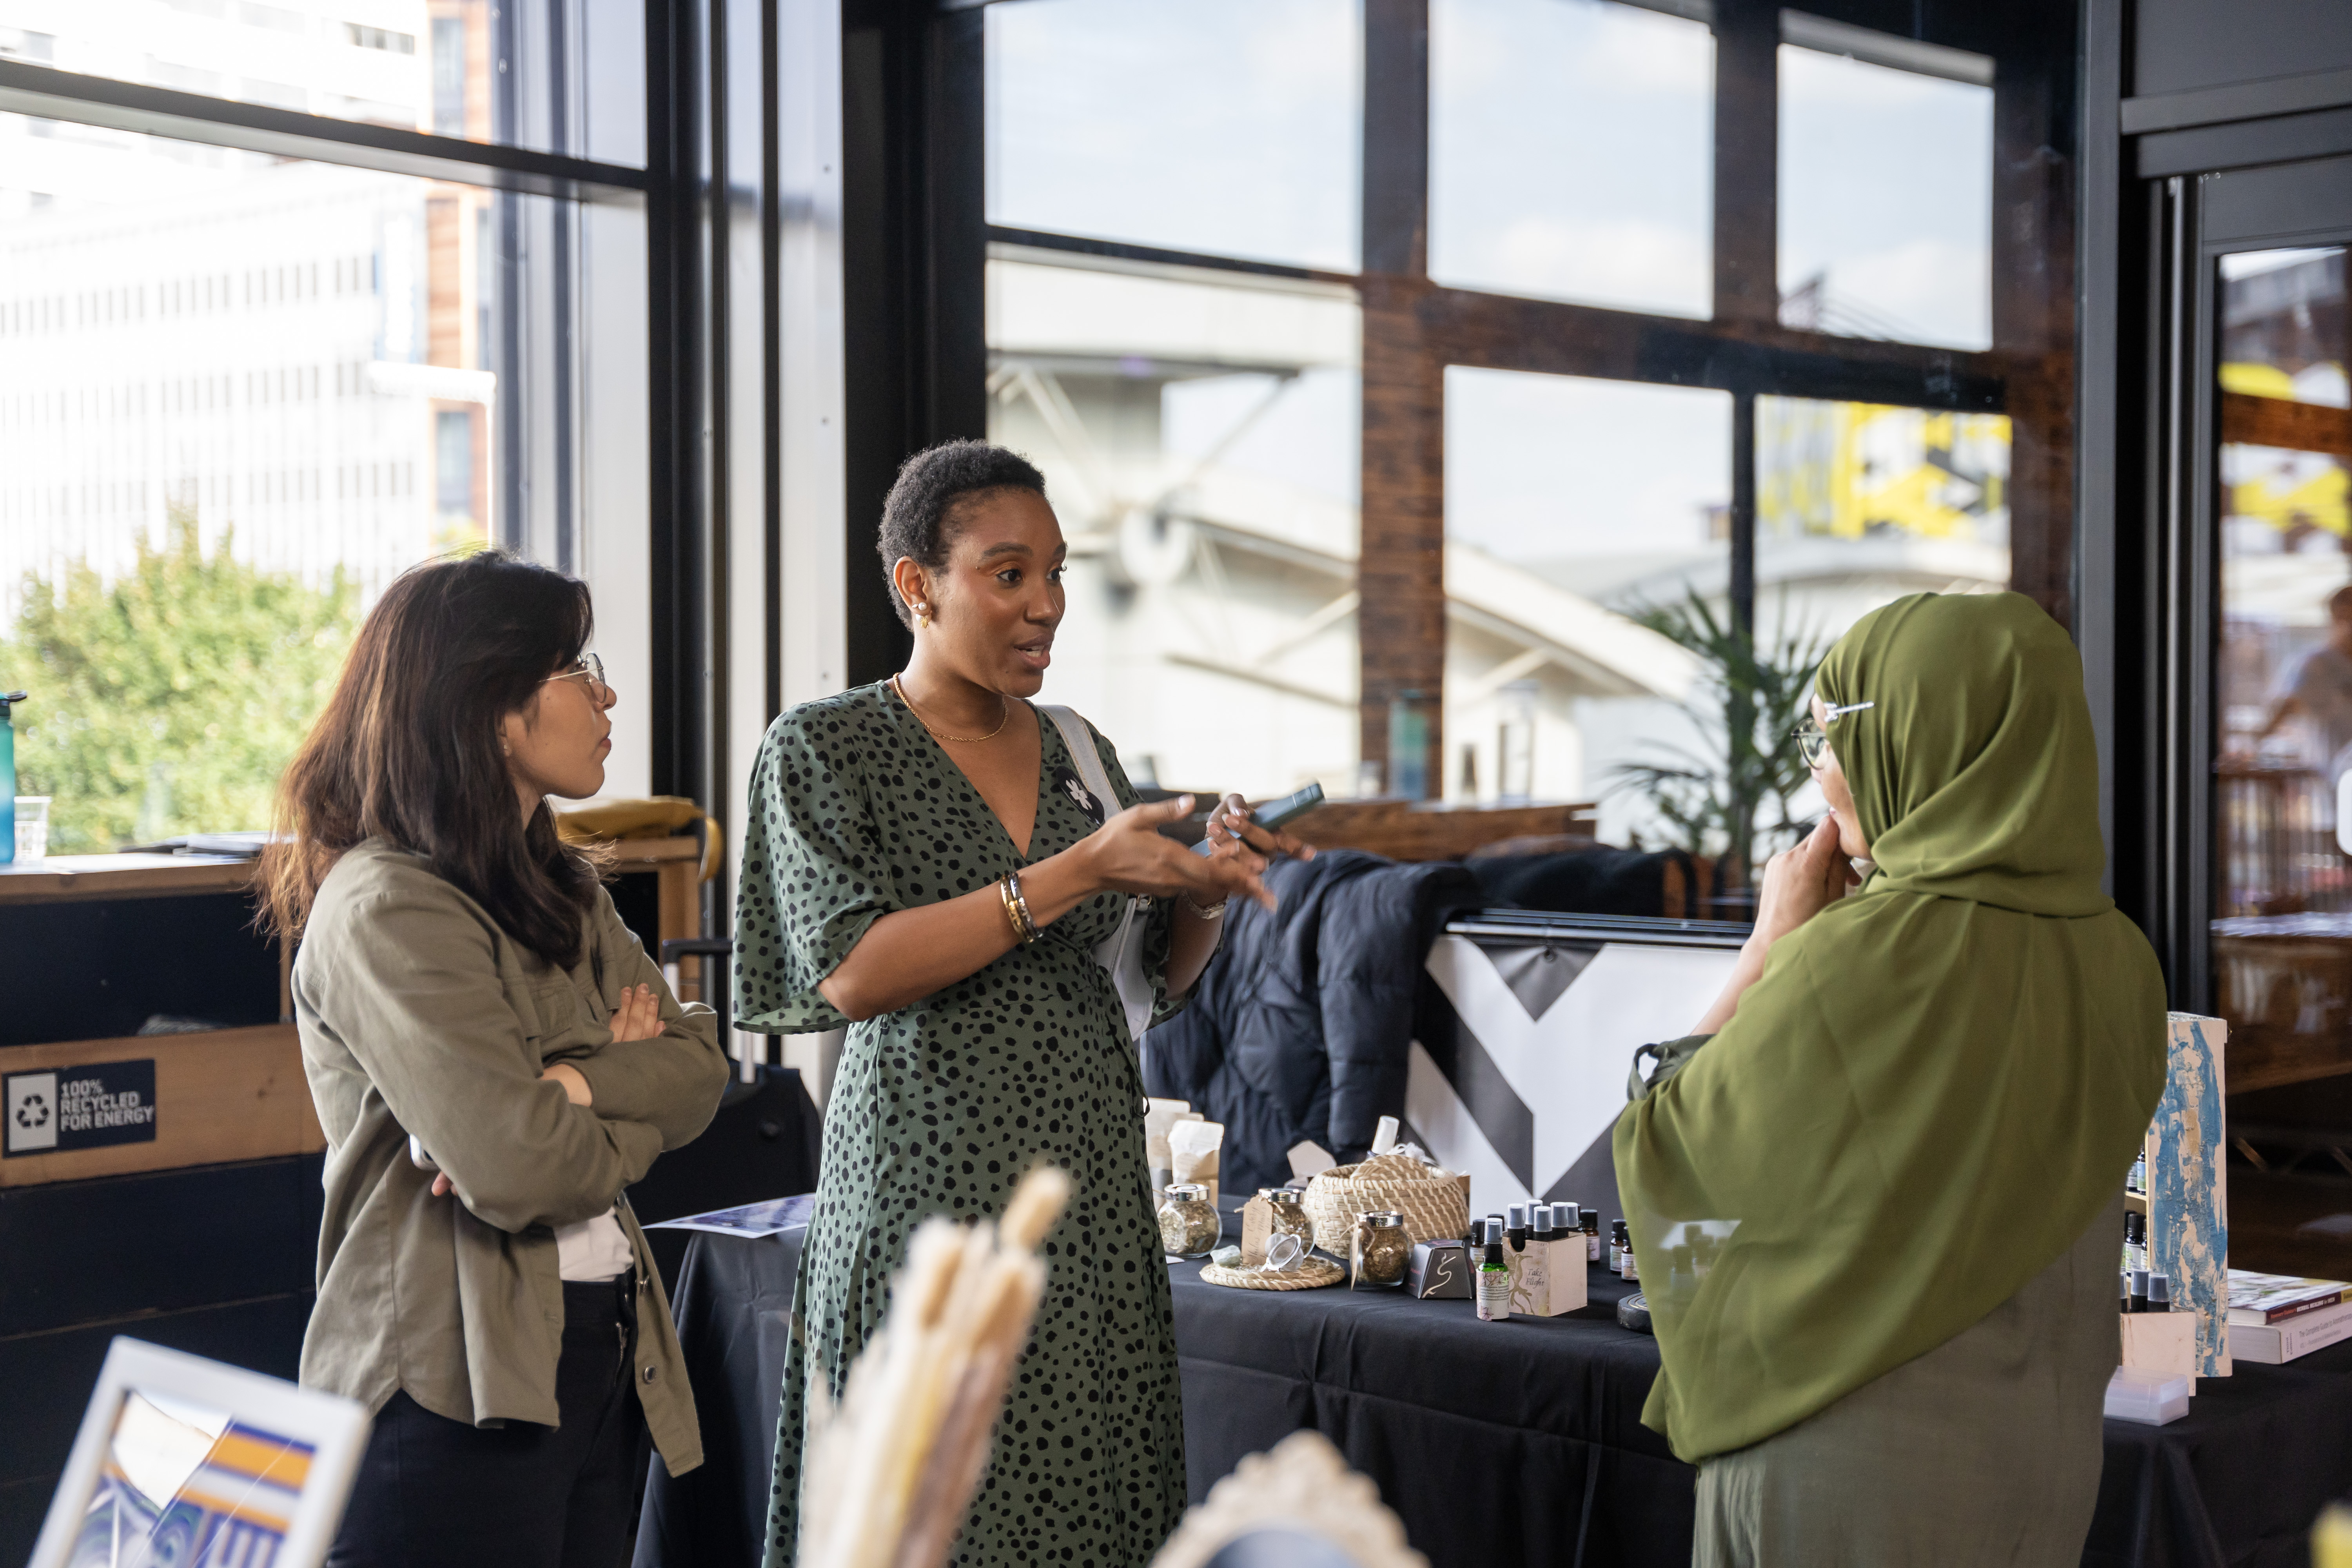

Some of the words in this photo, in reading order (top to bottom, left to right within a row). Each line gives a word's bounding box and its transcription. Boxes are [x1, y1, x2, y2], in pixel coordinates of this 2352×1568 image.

[61, 1079, 104, 1098] 100%
[61, 1091, 140, 1114] RECYCLED
[61, 1113, 93, 1132] FOR
[94, 1105, 155, 1128] ENERGY
[1528, 1268, 1542, 1276] Take
[1526, 1278, 1544, 1289] Flight
